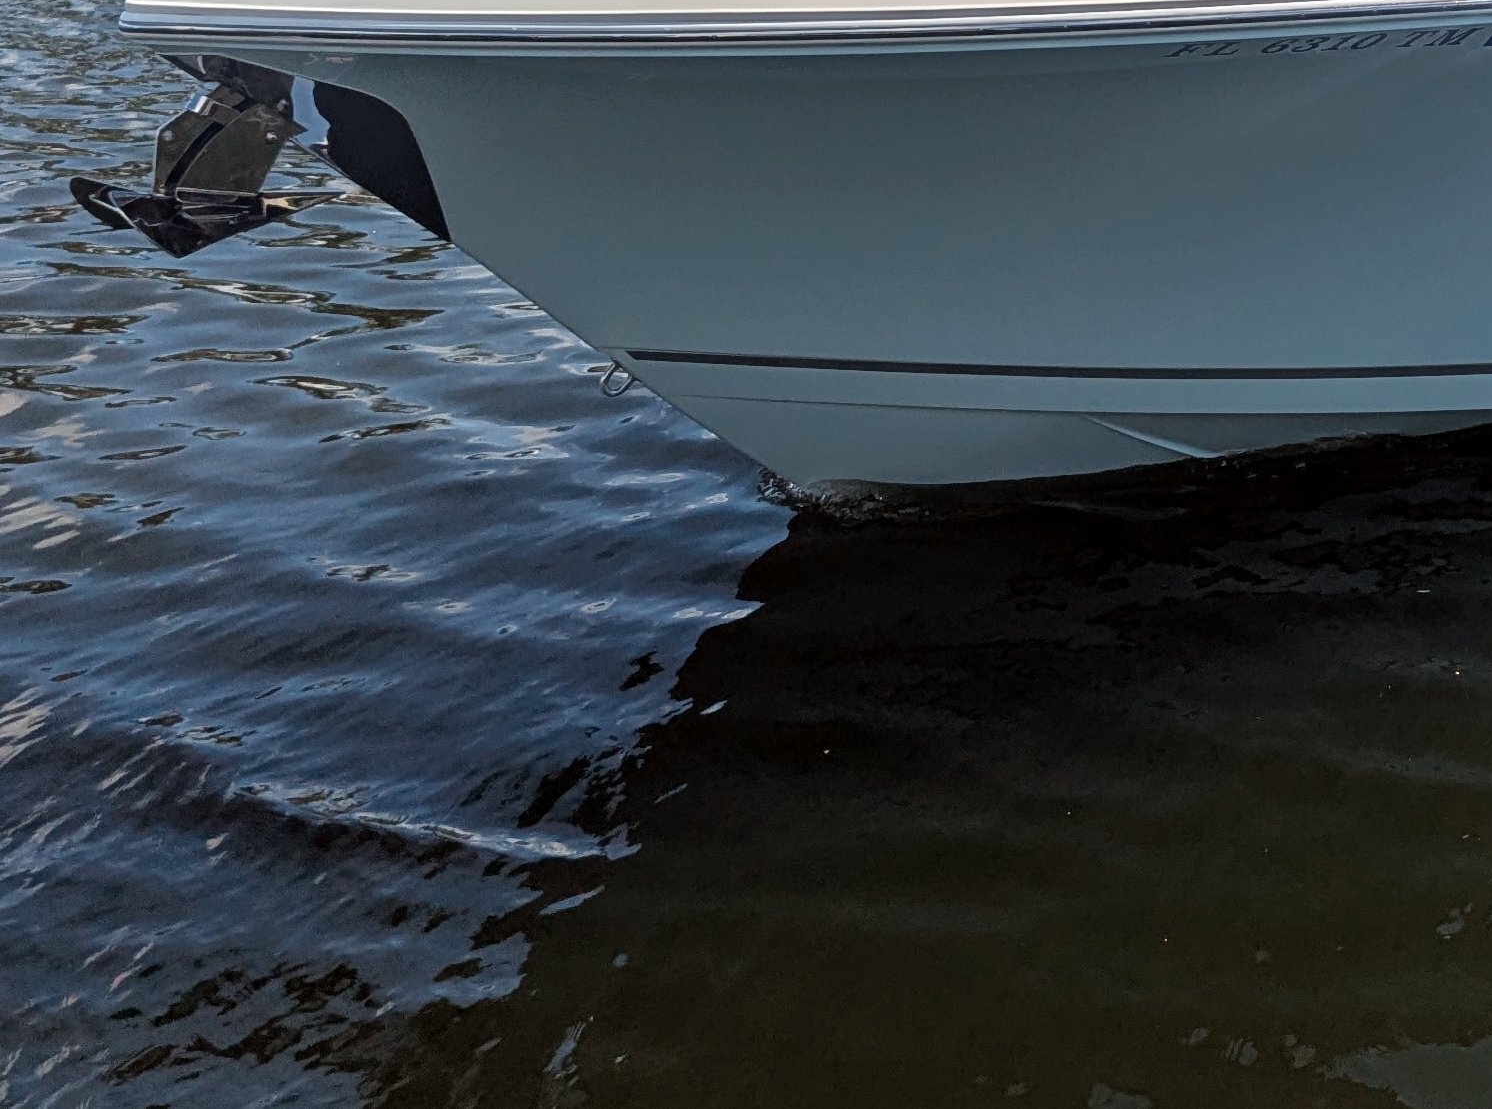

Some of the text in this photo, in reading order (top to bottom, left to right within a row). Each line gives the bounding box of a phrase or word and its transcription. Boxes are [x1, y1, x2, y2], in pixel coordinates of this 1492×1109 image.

[1163, 40, 1241, 58] FL
[1259, 32, 1388, 55] 6310
[1394, 26, 1485, 48] TM
